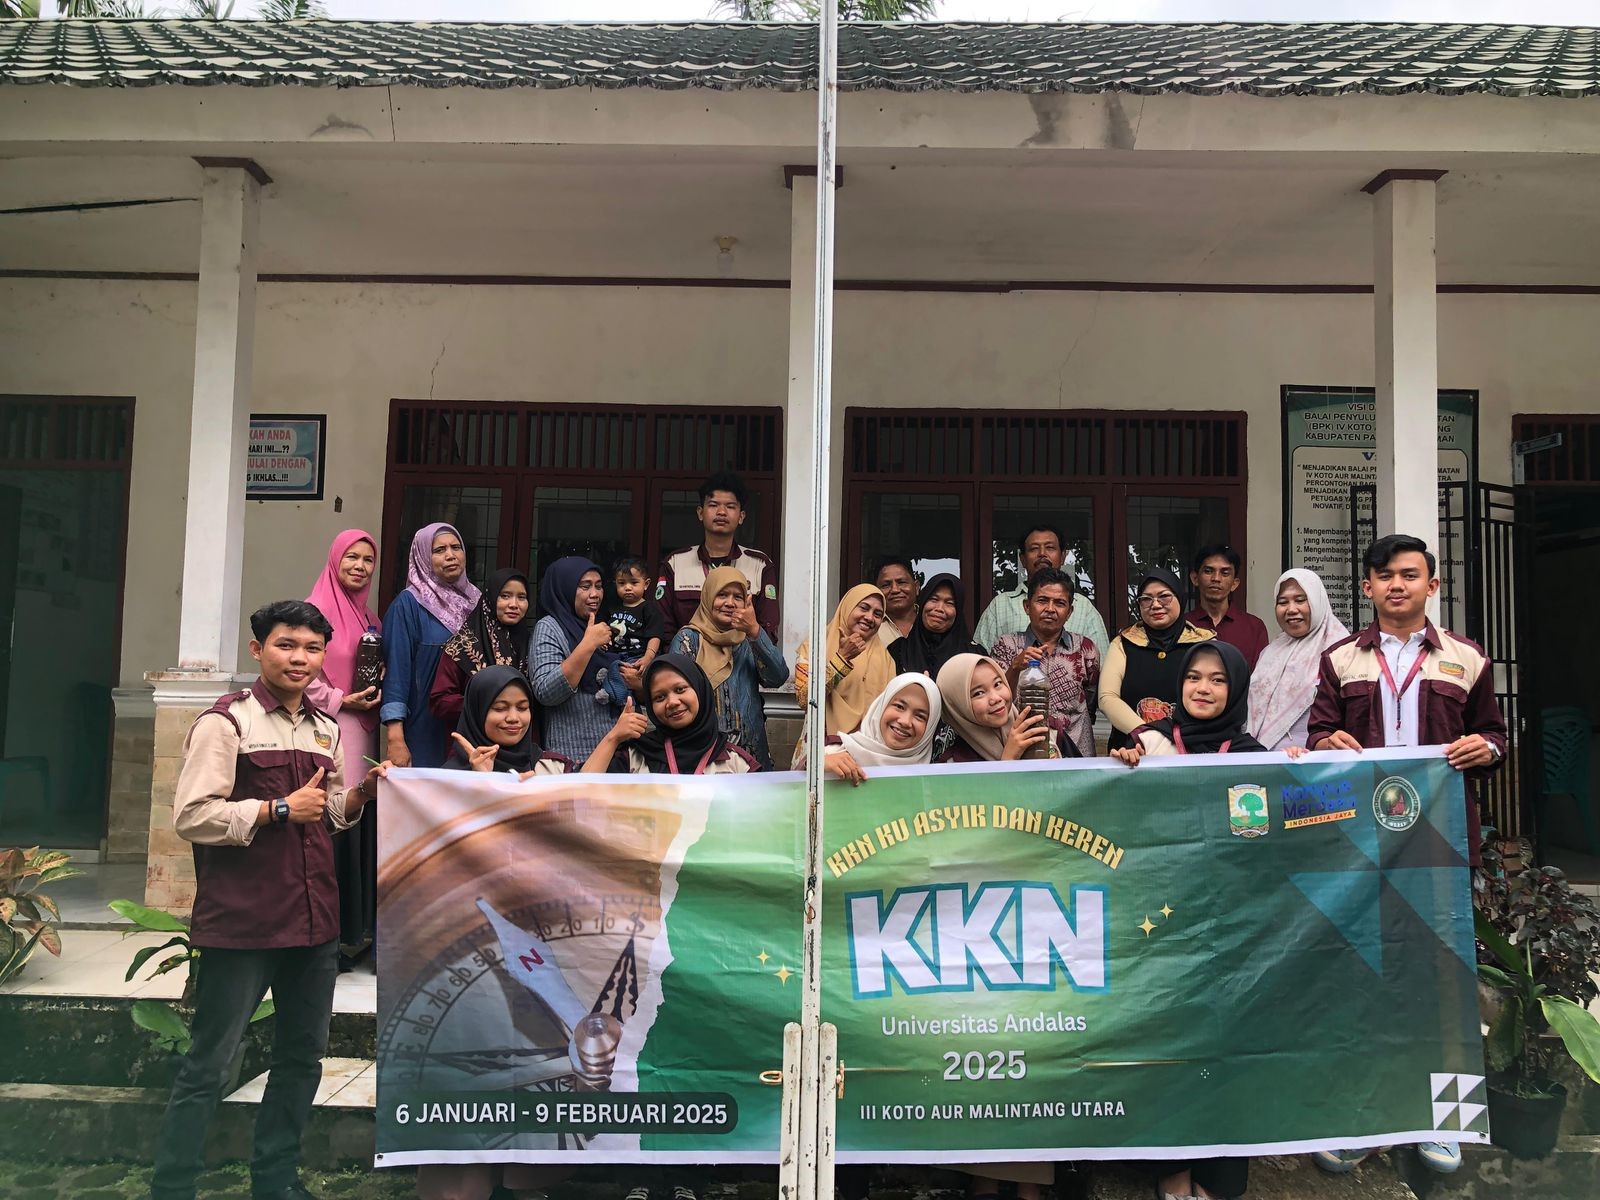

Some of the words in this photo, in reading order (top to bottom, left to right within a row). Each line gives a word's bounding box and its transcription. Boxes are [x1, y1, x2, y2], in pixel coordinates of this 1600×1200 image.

[267, 430, 291, 440] ANDA
[1305, 432, 1360, 440] KABUPATEN
[1309, 422, 1334, 430] (BPK)
[271, 458, 306, 469] DENGAN
[1290, 814, 1331, 827] INDONESIA
[1334, 811, 1352, 820] JAYA
[826, 833, 877, 879] KKN
[875, 817, 910, 849] KU
[913, 804, 987, 837] ASYIK
[992, 805, 1043, 835] DAN
[1045, 815, 1125, 871] KEREN
[846, 882, 1110, 999] KKN
[518, 947, 544, 972] N
[881, 1015, 999, 1036] Universitas
[1004, 1011, 1087, 1033] Andalas
[942, 1050, 1027, 1081] 2025
[395, 1104, 410, 1124] 6
[415, 1102, 516, 1124] JANUARI
[536, 1103, 549, 1123] 9
[556, 1103, 667, 1124] FEBRUARI
[672, 1104, 727, 1124] 2025
[860, 1104, 876, 1120] III
[882, 1104, 926, 1120] KOTO
[931, 1104, 964, 1120] AUR
[969, 1102, 1066, 1119] MALINTANG
[1071, 1101, 1126, 1117] UTARA
